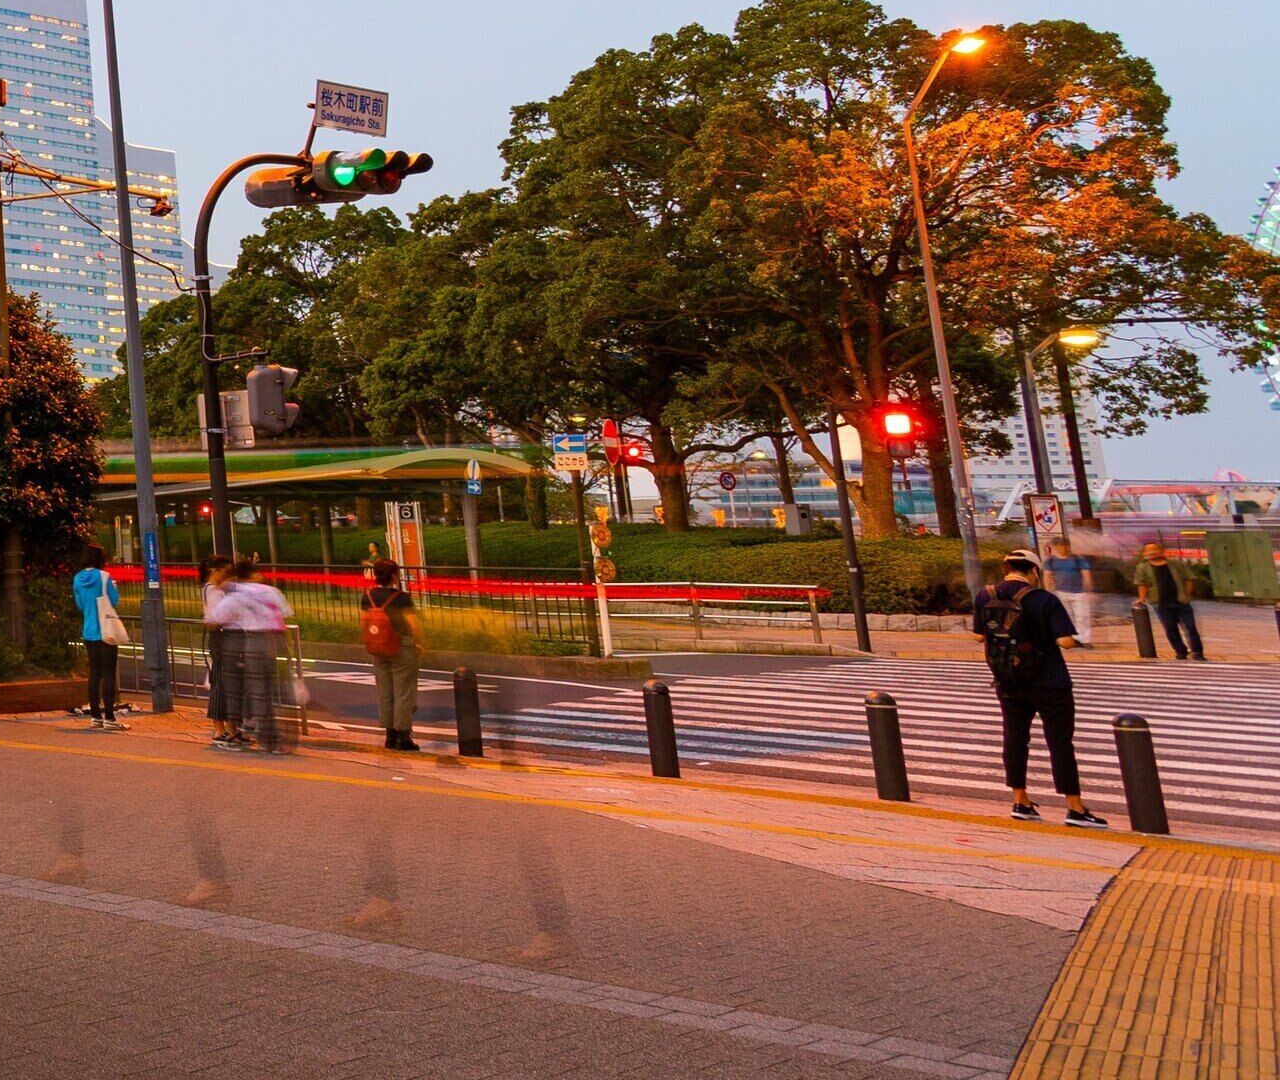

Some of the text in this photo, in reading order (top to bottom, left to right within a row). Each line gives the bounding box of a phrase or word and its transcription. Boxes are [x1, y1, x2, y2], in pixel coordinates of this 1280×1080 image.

[321, 88, 384, 117] 桜木町駅前
[321, 109, 381, 130] Sakuragicho Sta.
[558, 457, 585, 466] ここから
[401, 506, 412, 518] 6
